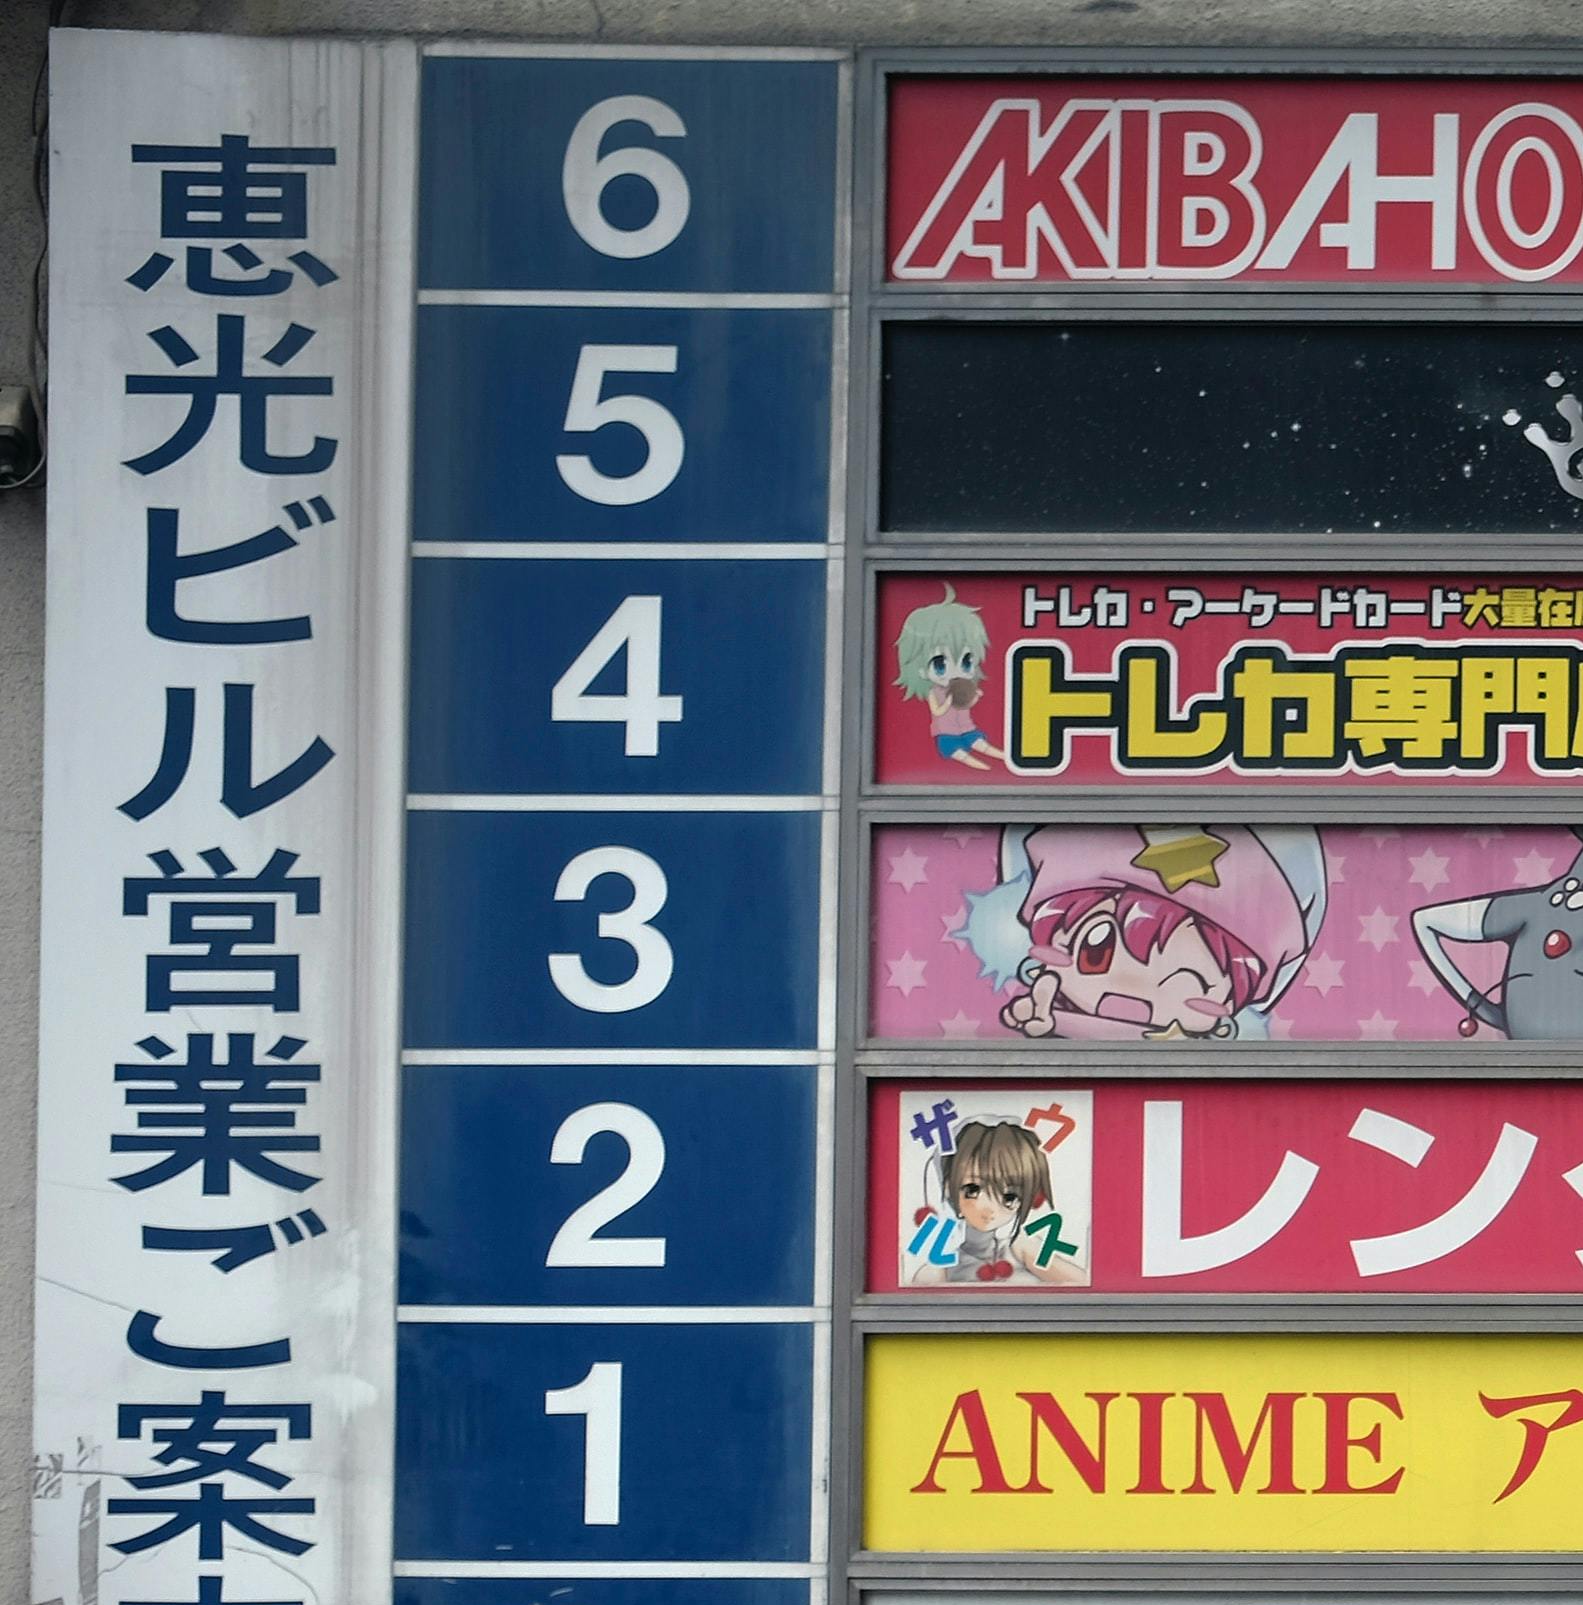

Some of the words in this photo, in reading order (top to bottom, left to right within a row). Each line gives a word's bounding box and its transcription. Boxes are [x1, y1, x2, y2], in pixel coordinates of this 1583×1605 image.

[562, 94, 690, 259] 6
[556, 344, 685, 506] 5
[552, 595, 683, 757] 4
[554, 845, 674, 1013] 3
[546, 1102, 666, 1268] 2
[545, 1362, 622, 1525] 1
[910, 1390, 1406, 1495] ANIME
